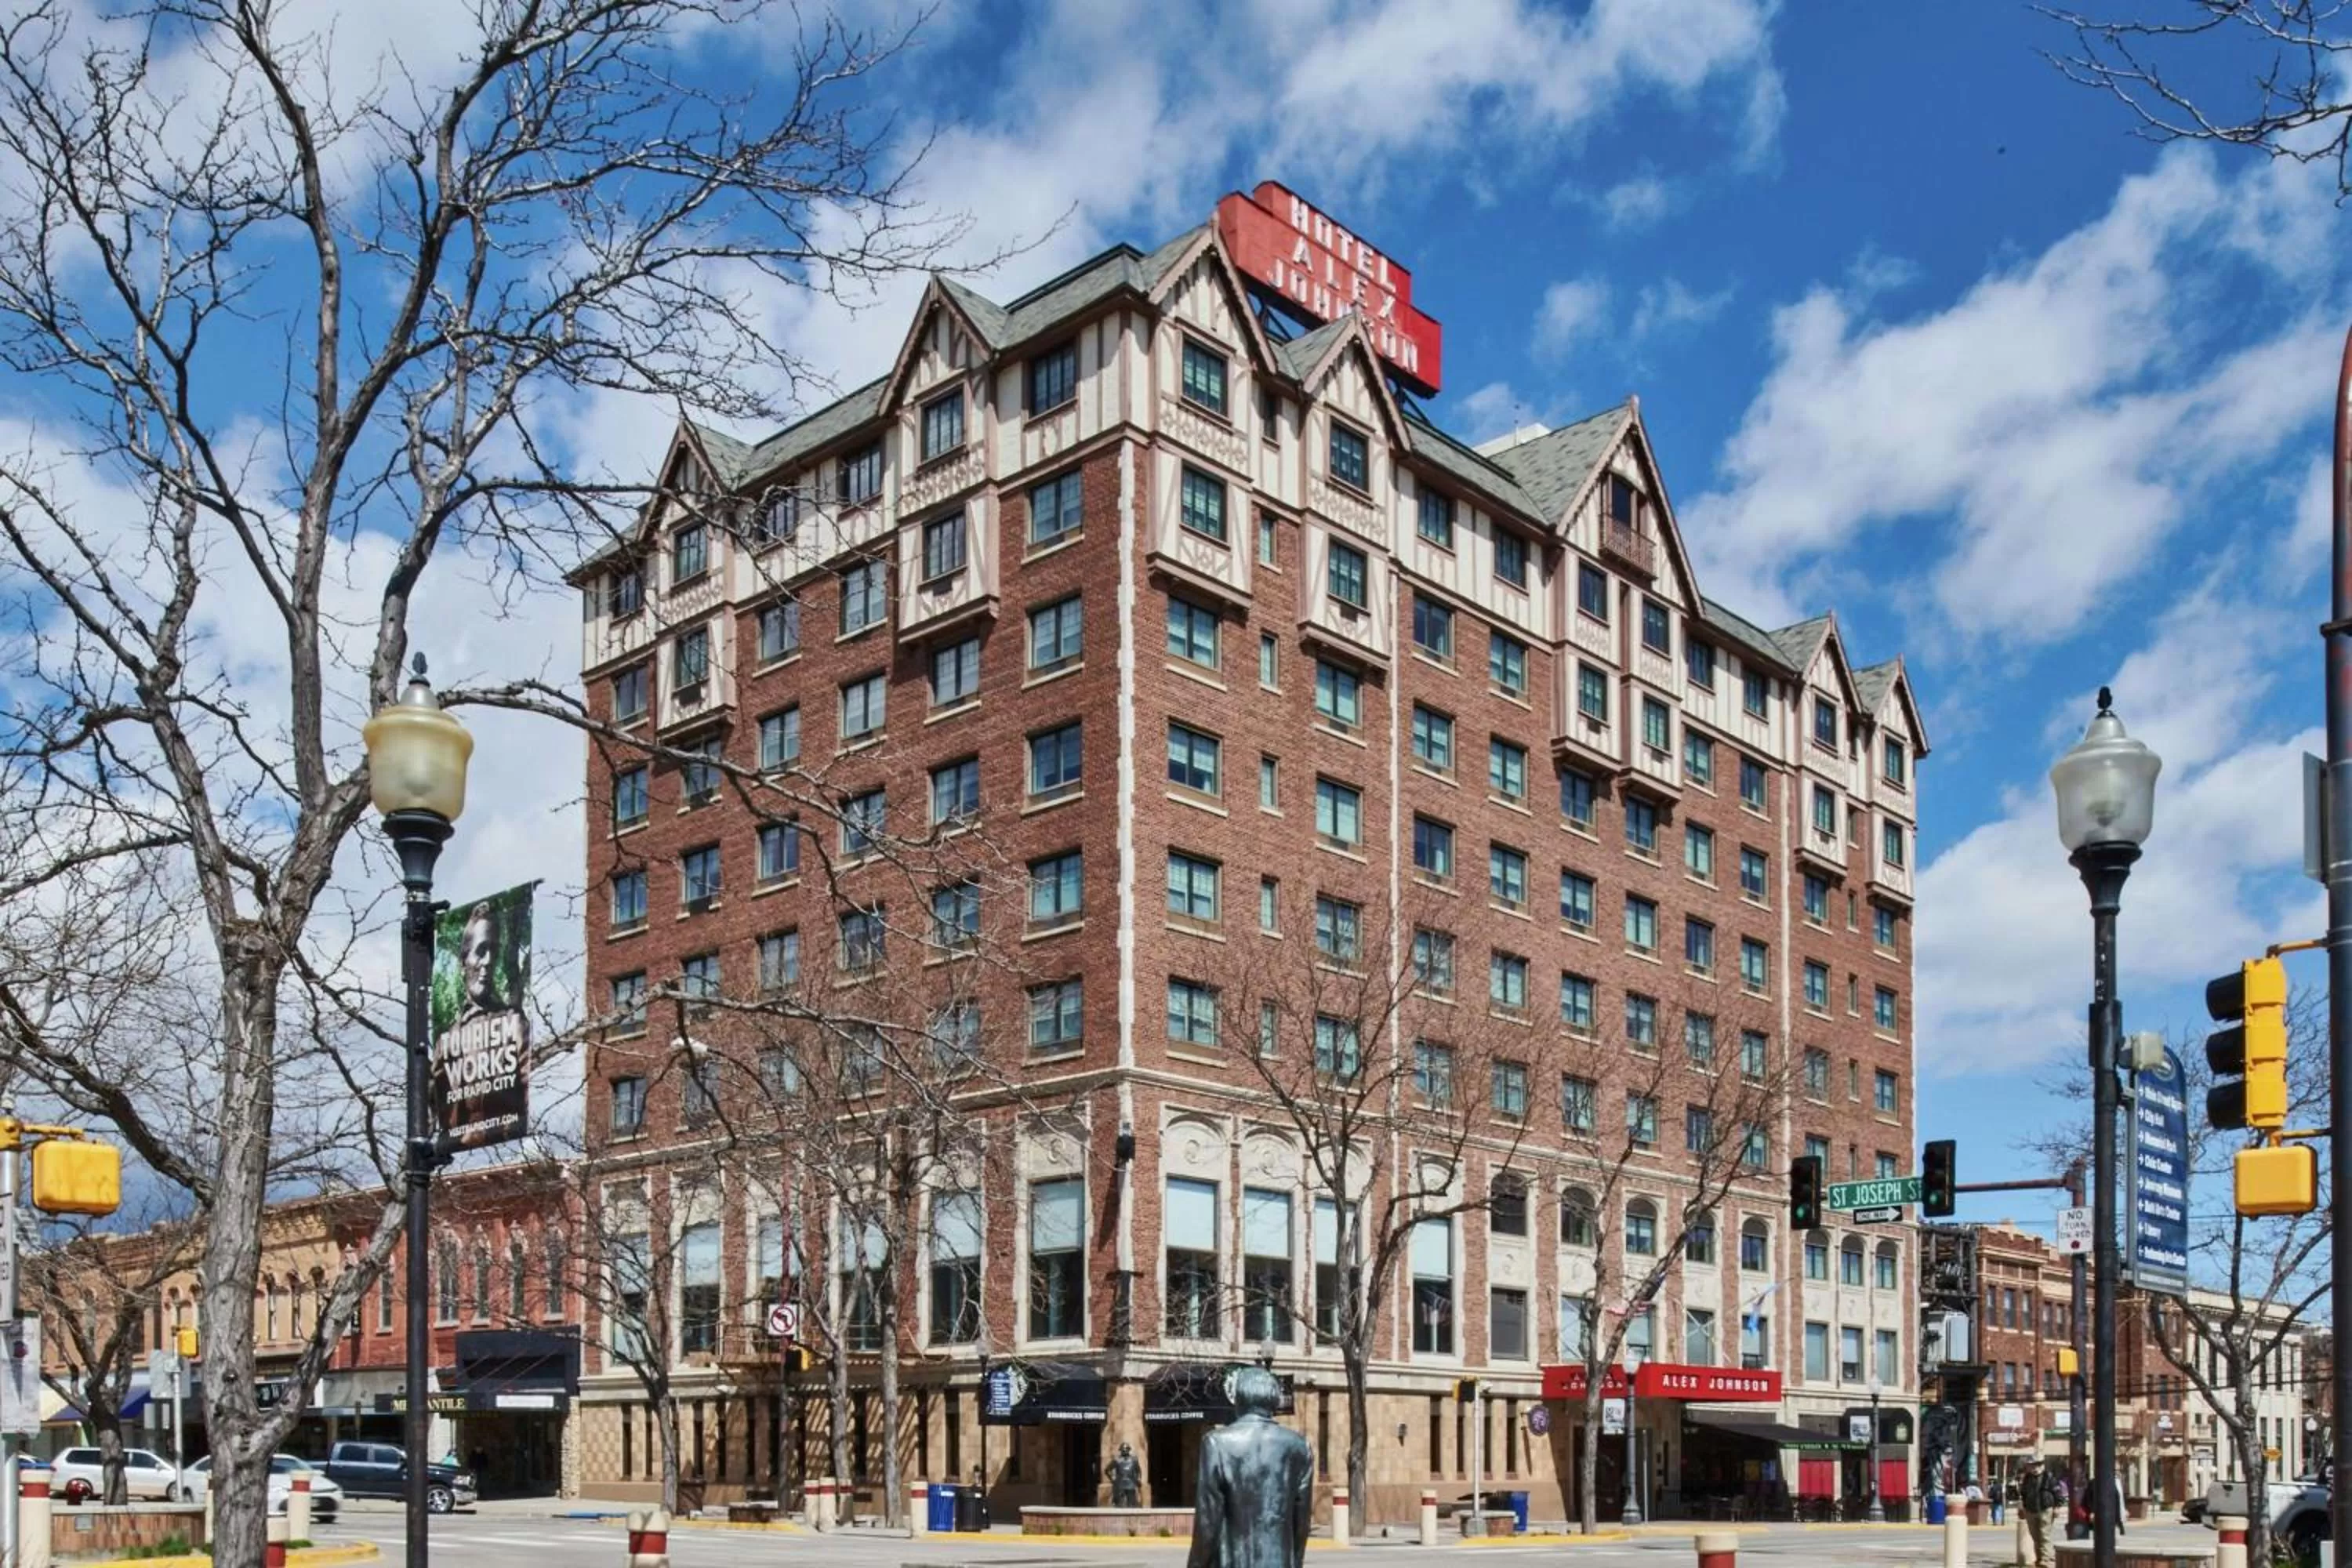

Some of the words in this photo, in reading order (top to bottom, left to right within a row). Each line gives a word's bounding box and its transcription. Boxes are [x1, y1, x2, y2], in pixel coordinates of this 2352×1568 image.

[1291, 195, 1396, 292] HOTEL
[1292, 236, 1396, 328] ALEX
[441, 1014, 520, 1060] TOURISM
[445, 1045, 518, 1091] WORKS
[446, 1087, 463, 1104] FOR
[463, 1080, 492, 1099] RAPID
[493, 1073, 517, 1091] CITY
[1831, 1186, 1848, 1207] ST
[1853, 1181, 1902, 1205] JOSEPH
[2067, 1210, 2084, 1220] NO
[1661, 1374, 1699, 1388] ALEX
[1708, 1375, 1769, 1392] JOHNSON
